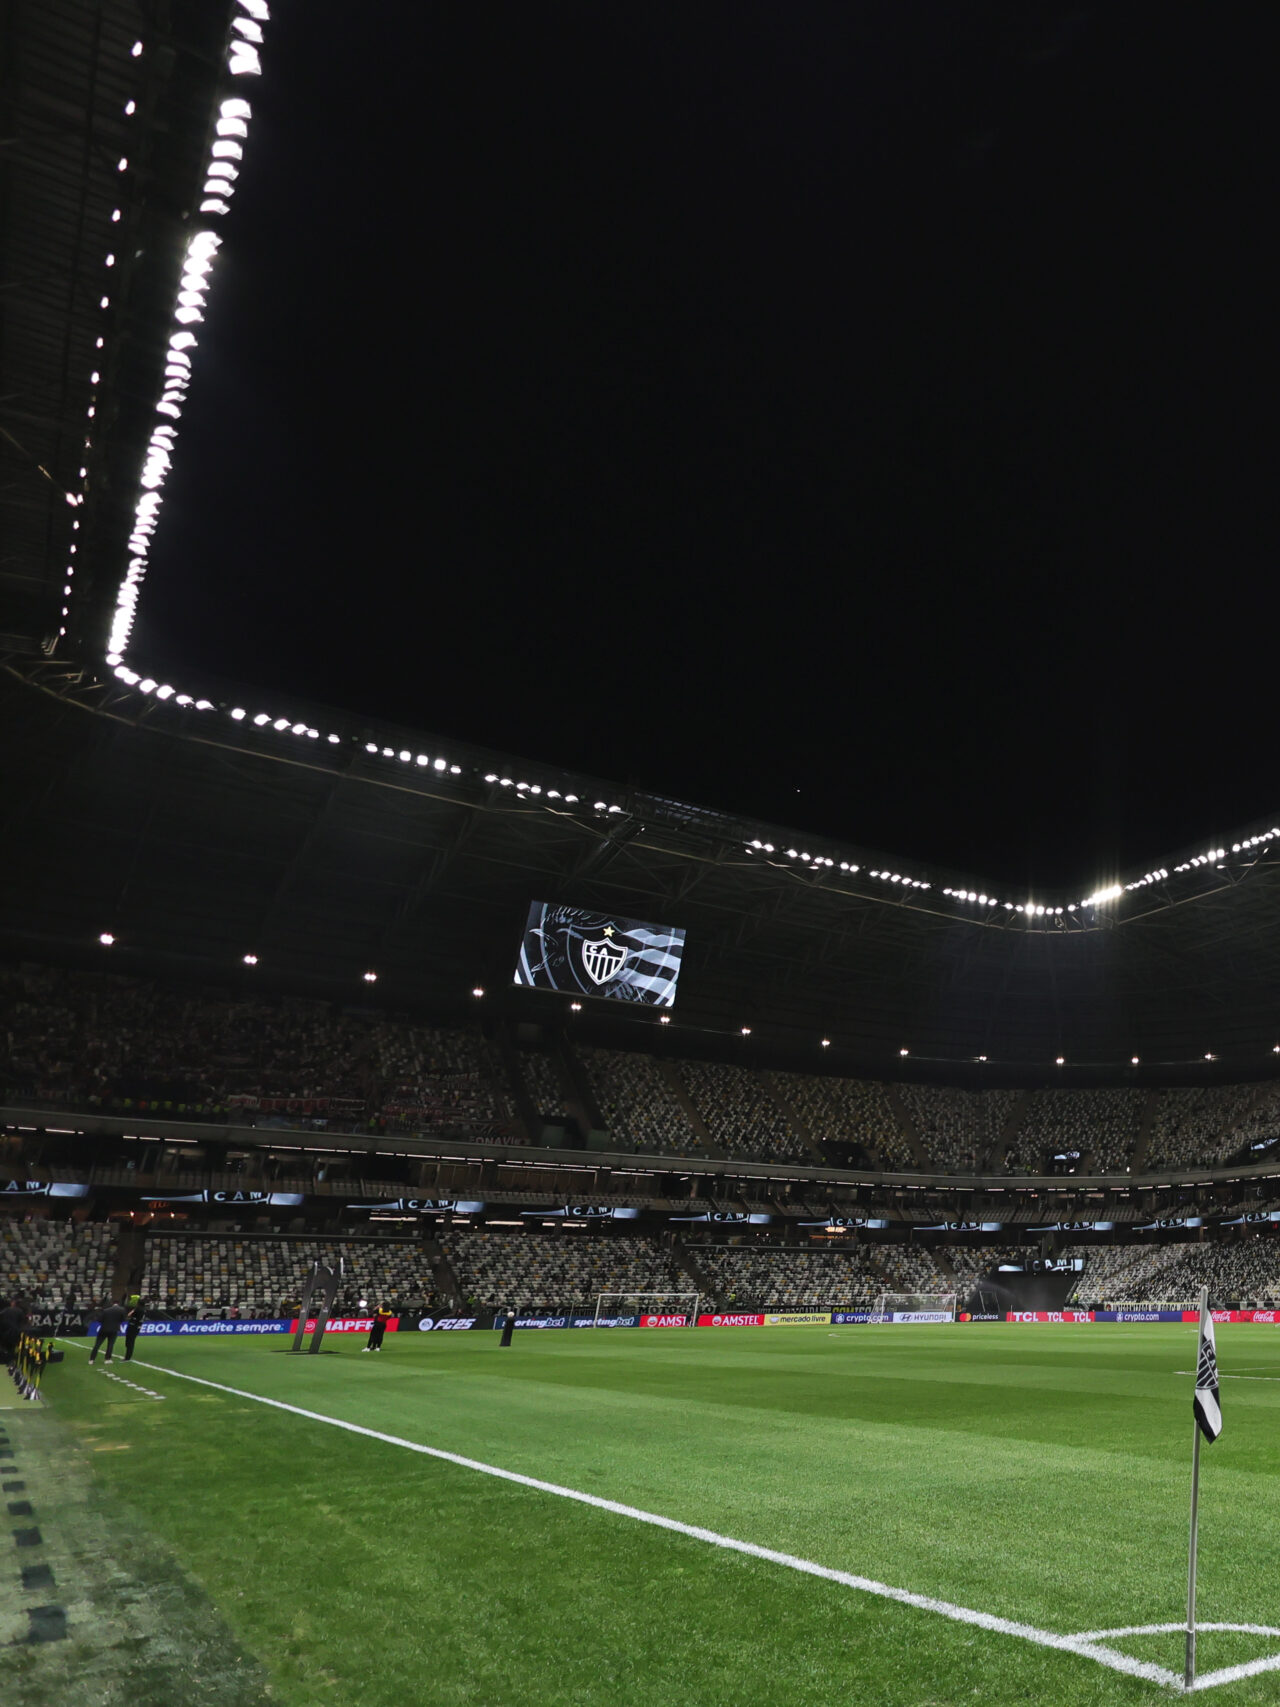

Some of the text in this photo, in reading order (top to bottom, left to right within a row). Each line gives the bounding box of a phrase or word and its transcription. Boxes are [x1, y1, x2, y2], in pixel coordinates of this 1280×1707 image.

[722, 1315, 759, 1326] AMSTEL
[780, 1315, 810, 1323] mercado
[914, 1313, 946, 1321] HYUNDAI
[972, 1313, 998, 1321] priceless
[1013, 1312, 1091, 1322] TCL TCL TCL
[1124, 1313, 1159, 1321] crypto.com
[180, 1323, 233, 1333] Acredite
